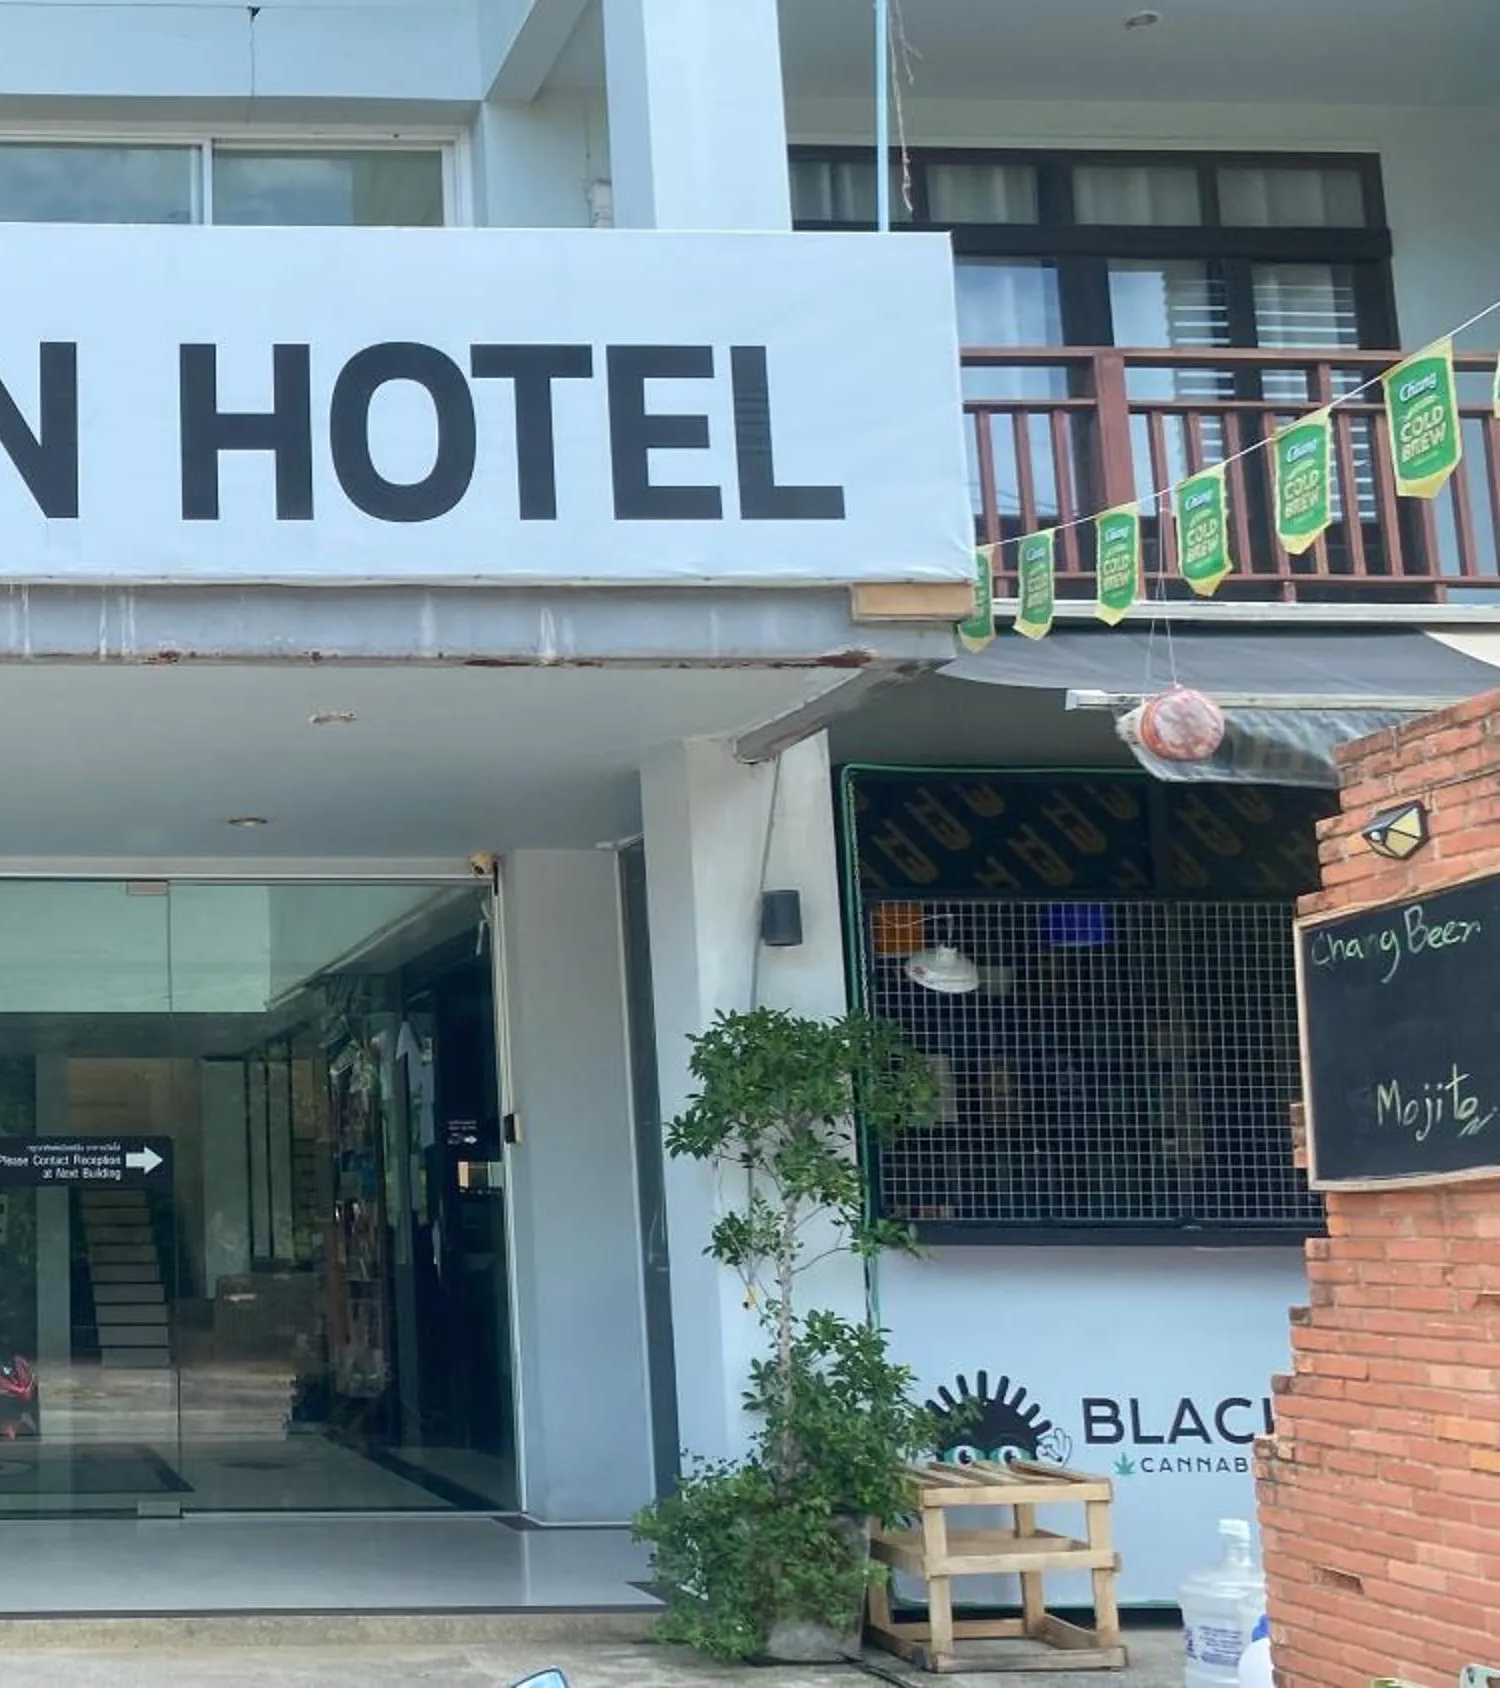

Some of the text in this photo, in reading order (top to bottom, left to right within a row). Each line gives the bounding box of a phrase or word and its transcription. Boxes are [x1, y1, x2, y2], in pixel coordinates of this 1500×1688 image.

[1399, 371, 1437, 403] Chang
[179, 342, 845, 523] HOTEL
[1400, 404, 1445, 442] COLD
[1401, 420, 1447, 463] BREW
[1284, 469, 1319, 500] COLD
[1187, 518, 1218, 547] COLD
[1404, 904, 1481, 954] Beer
[1377, 1063, 1478, 1141] Mojito
[32, 1155, 69, 1167] Contact
[73, 1155, 121, 1168] Reception
[43, 1167, 121, 1181] at Next Building
[1140, 1457, 1249, 1473] CANNAB
